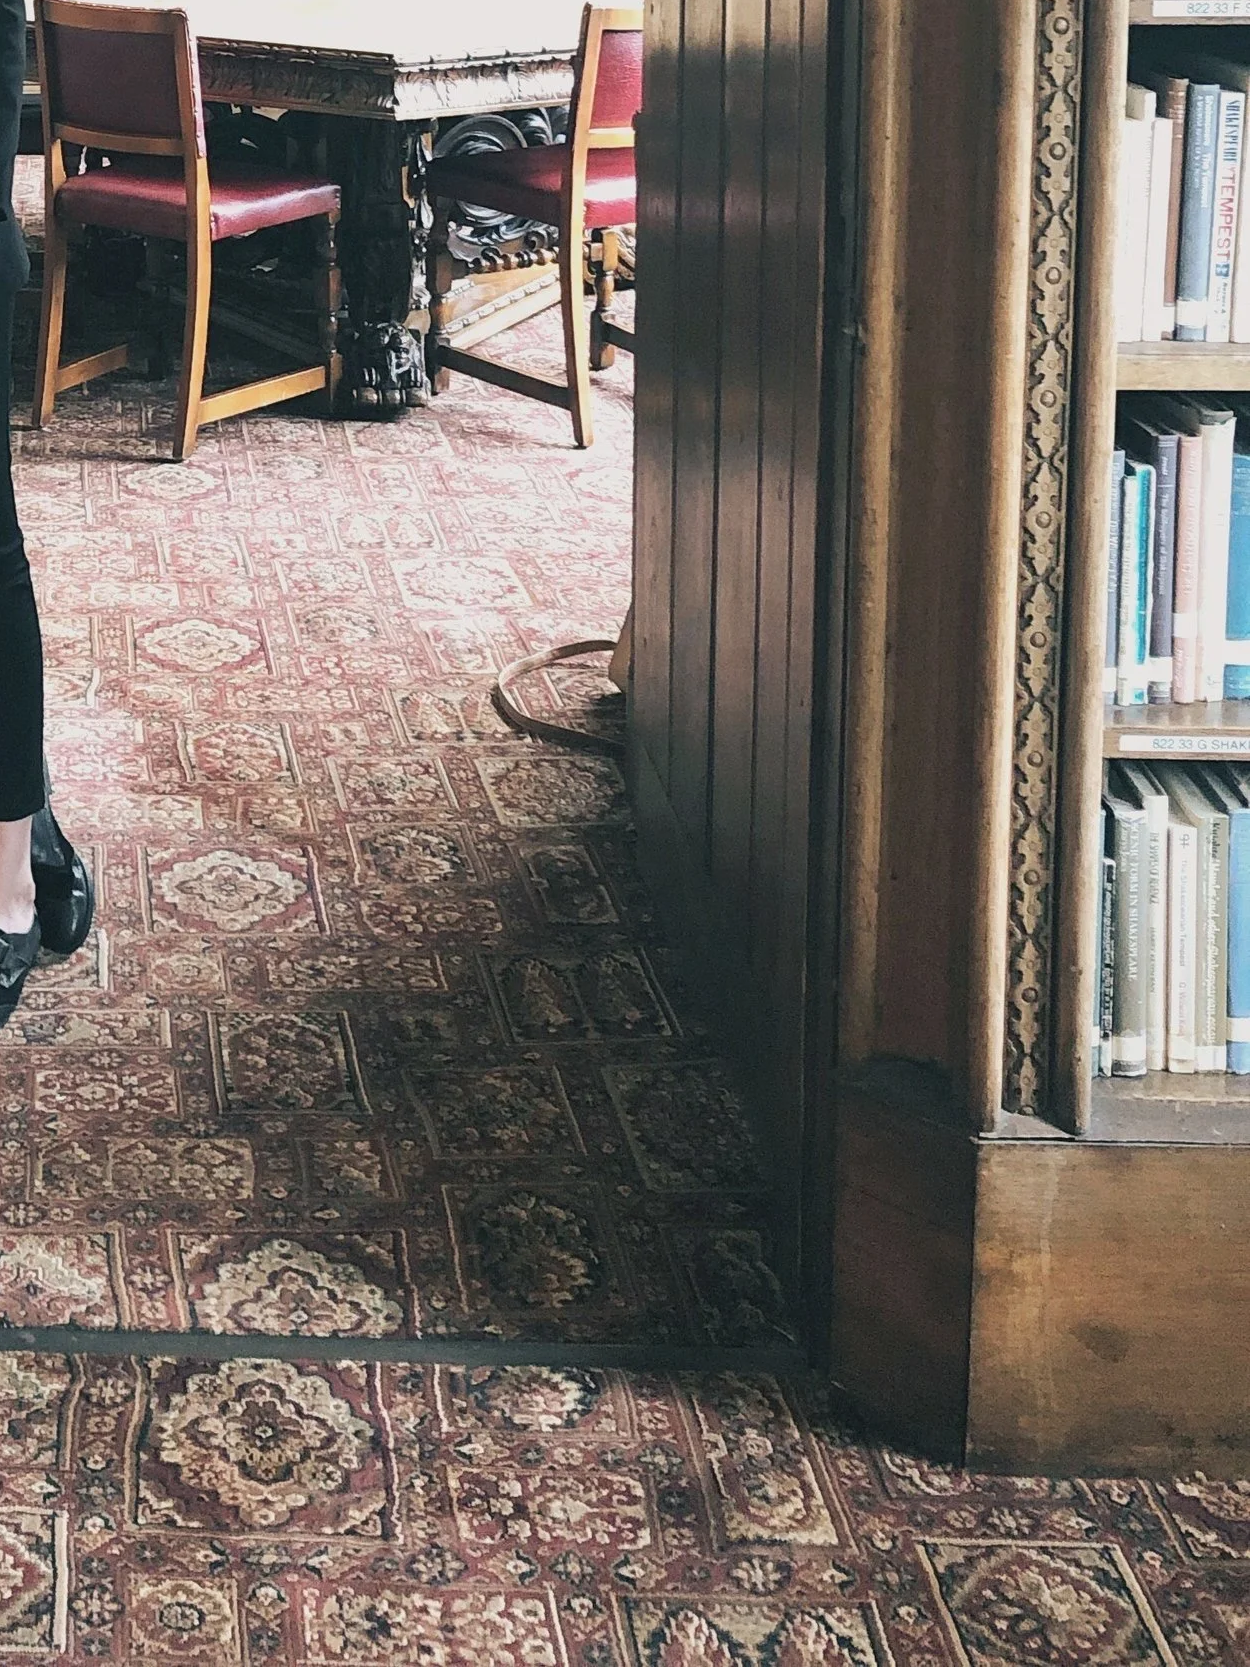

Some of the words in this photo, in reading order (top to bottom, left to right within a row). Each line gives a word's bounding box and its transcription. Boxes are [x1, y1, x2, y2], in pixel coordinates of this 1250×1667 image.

[1233, 3, 1241, 13] F
[1222, 99, 1242, 163] SHAKESPEARE
[1216, 173, 1236, 262] TEMPEST
[1197, 739, 1207, 750] G
[1211, 739, 1250, 751] SHAK
[1129, 894, 1139, 906] IN
[1127, 907, 1139, 981] SHAKESPEARE
[1178, 933, 1187, 967] Tempest
